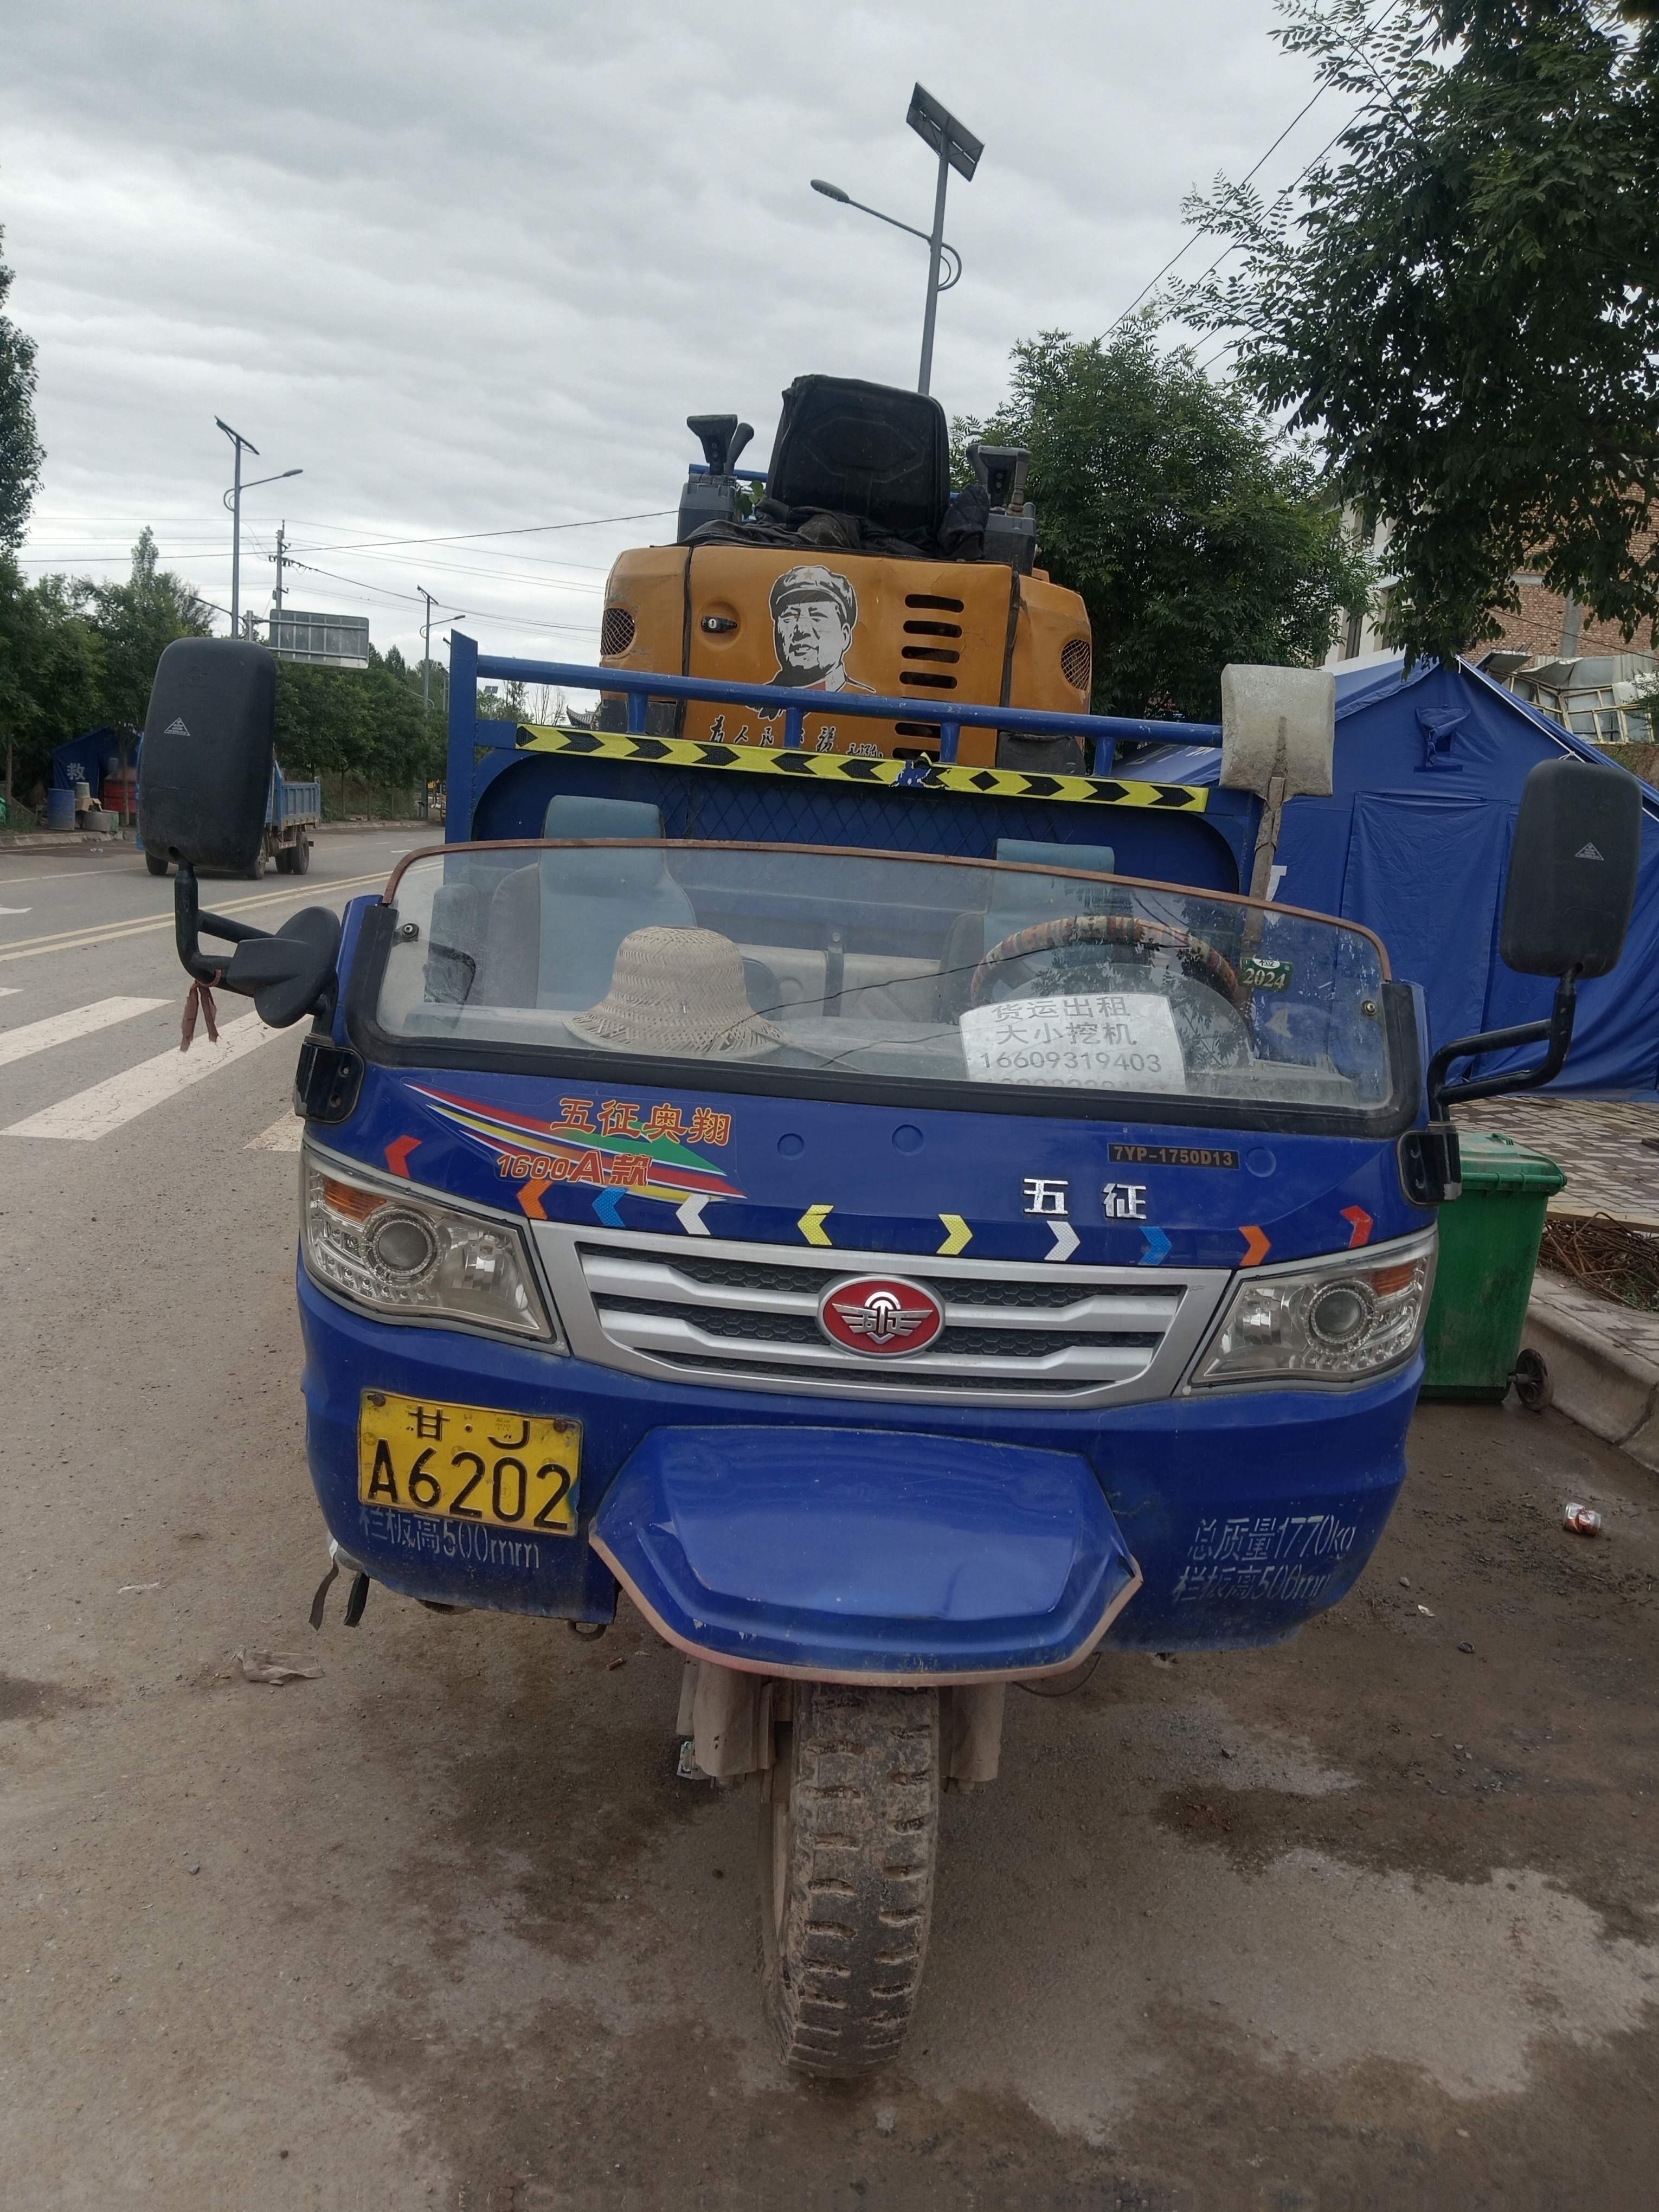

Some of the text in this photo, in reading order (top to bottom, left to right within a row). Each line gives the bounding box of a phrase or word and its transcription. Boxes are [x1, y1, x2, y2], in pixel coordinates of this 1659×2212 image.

[67, 762, 86, 780] 救
[1243, 968, 1285, 989] 2024
[992, 996, 1131, 1023] 货运出租
[996, 1021, 1137, 1045] 大小挖机
[981, 1051, 1162, 1073] 16609319403
[549, 1097, 732, 1146] 五征奥翔
[495, 1149, 653, 1187] 1600A款
[1114, 1145, 1232, 1166] 7YP-1750D13
[1023, 1178, 1147, 1219] 五征
[368, 1438, 573, 1530] A6202
[1187, 1515, 1356, 1560] 总质量1770kg
